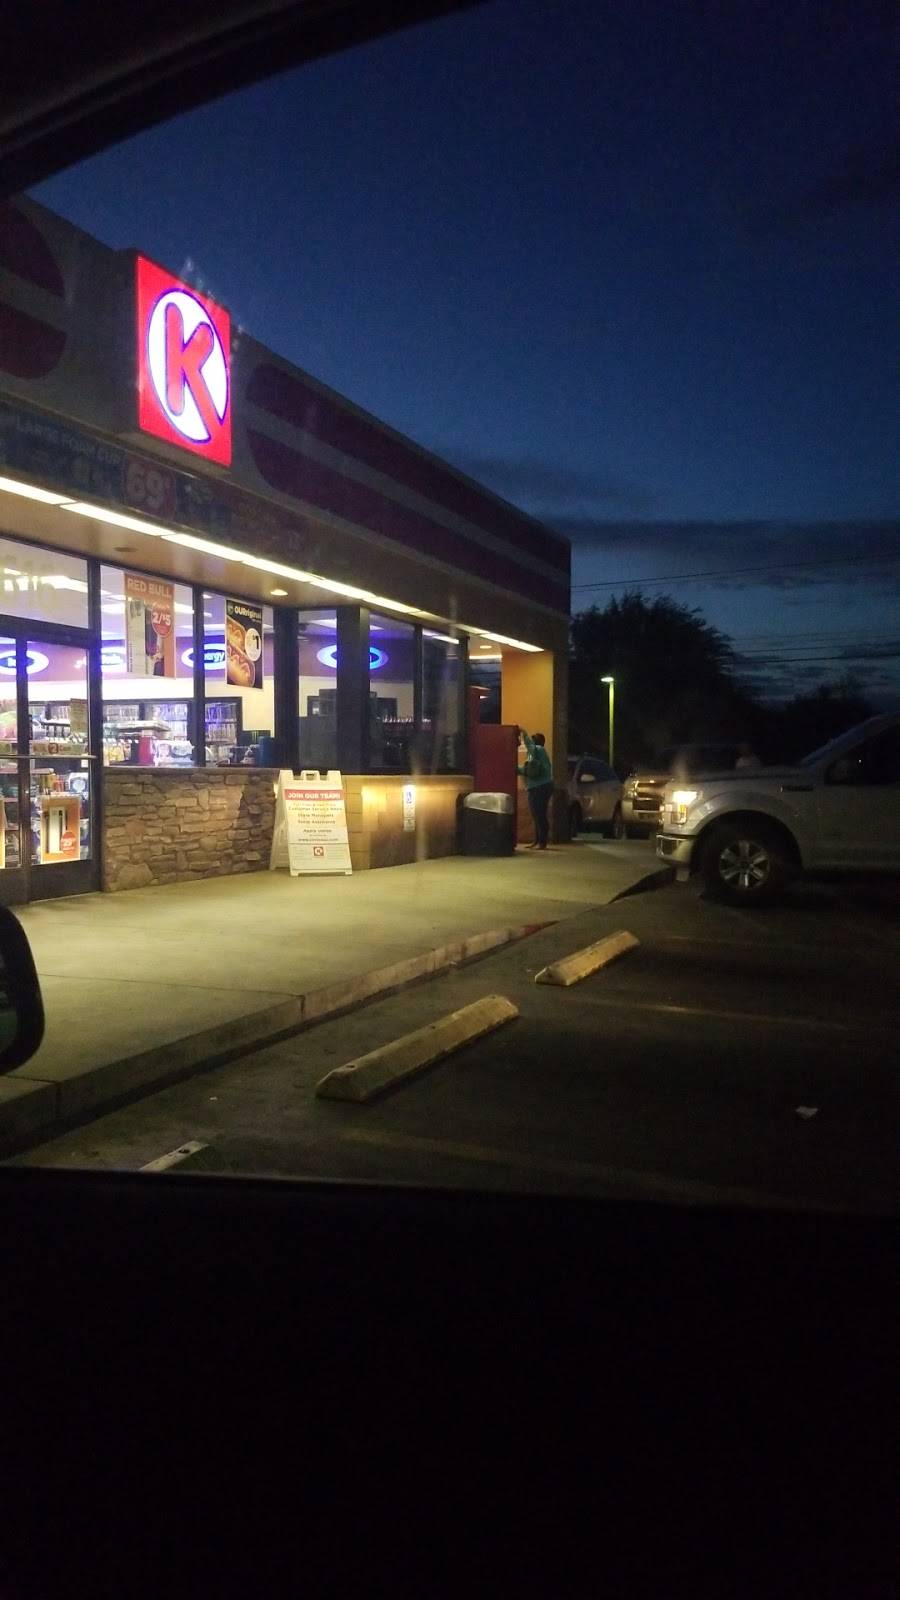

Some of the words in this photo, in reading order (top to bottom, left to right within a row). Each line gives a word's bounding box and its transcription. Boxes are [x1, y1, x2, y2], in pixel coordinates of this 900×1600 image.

[164, 301, 223, 441] K
[127, 577, 147, 593] RED
[148, 583, 172, 599] BULL
